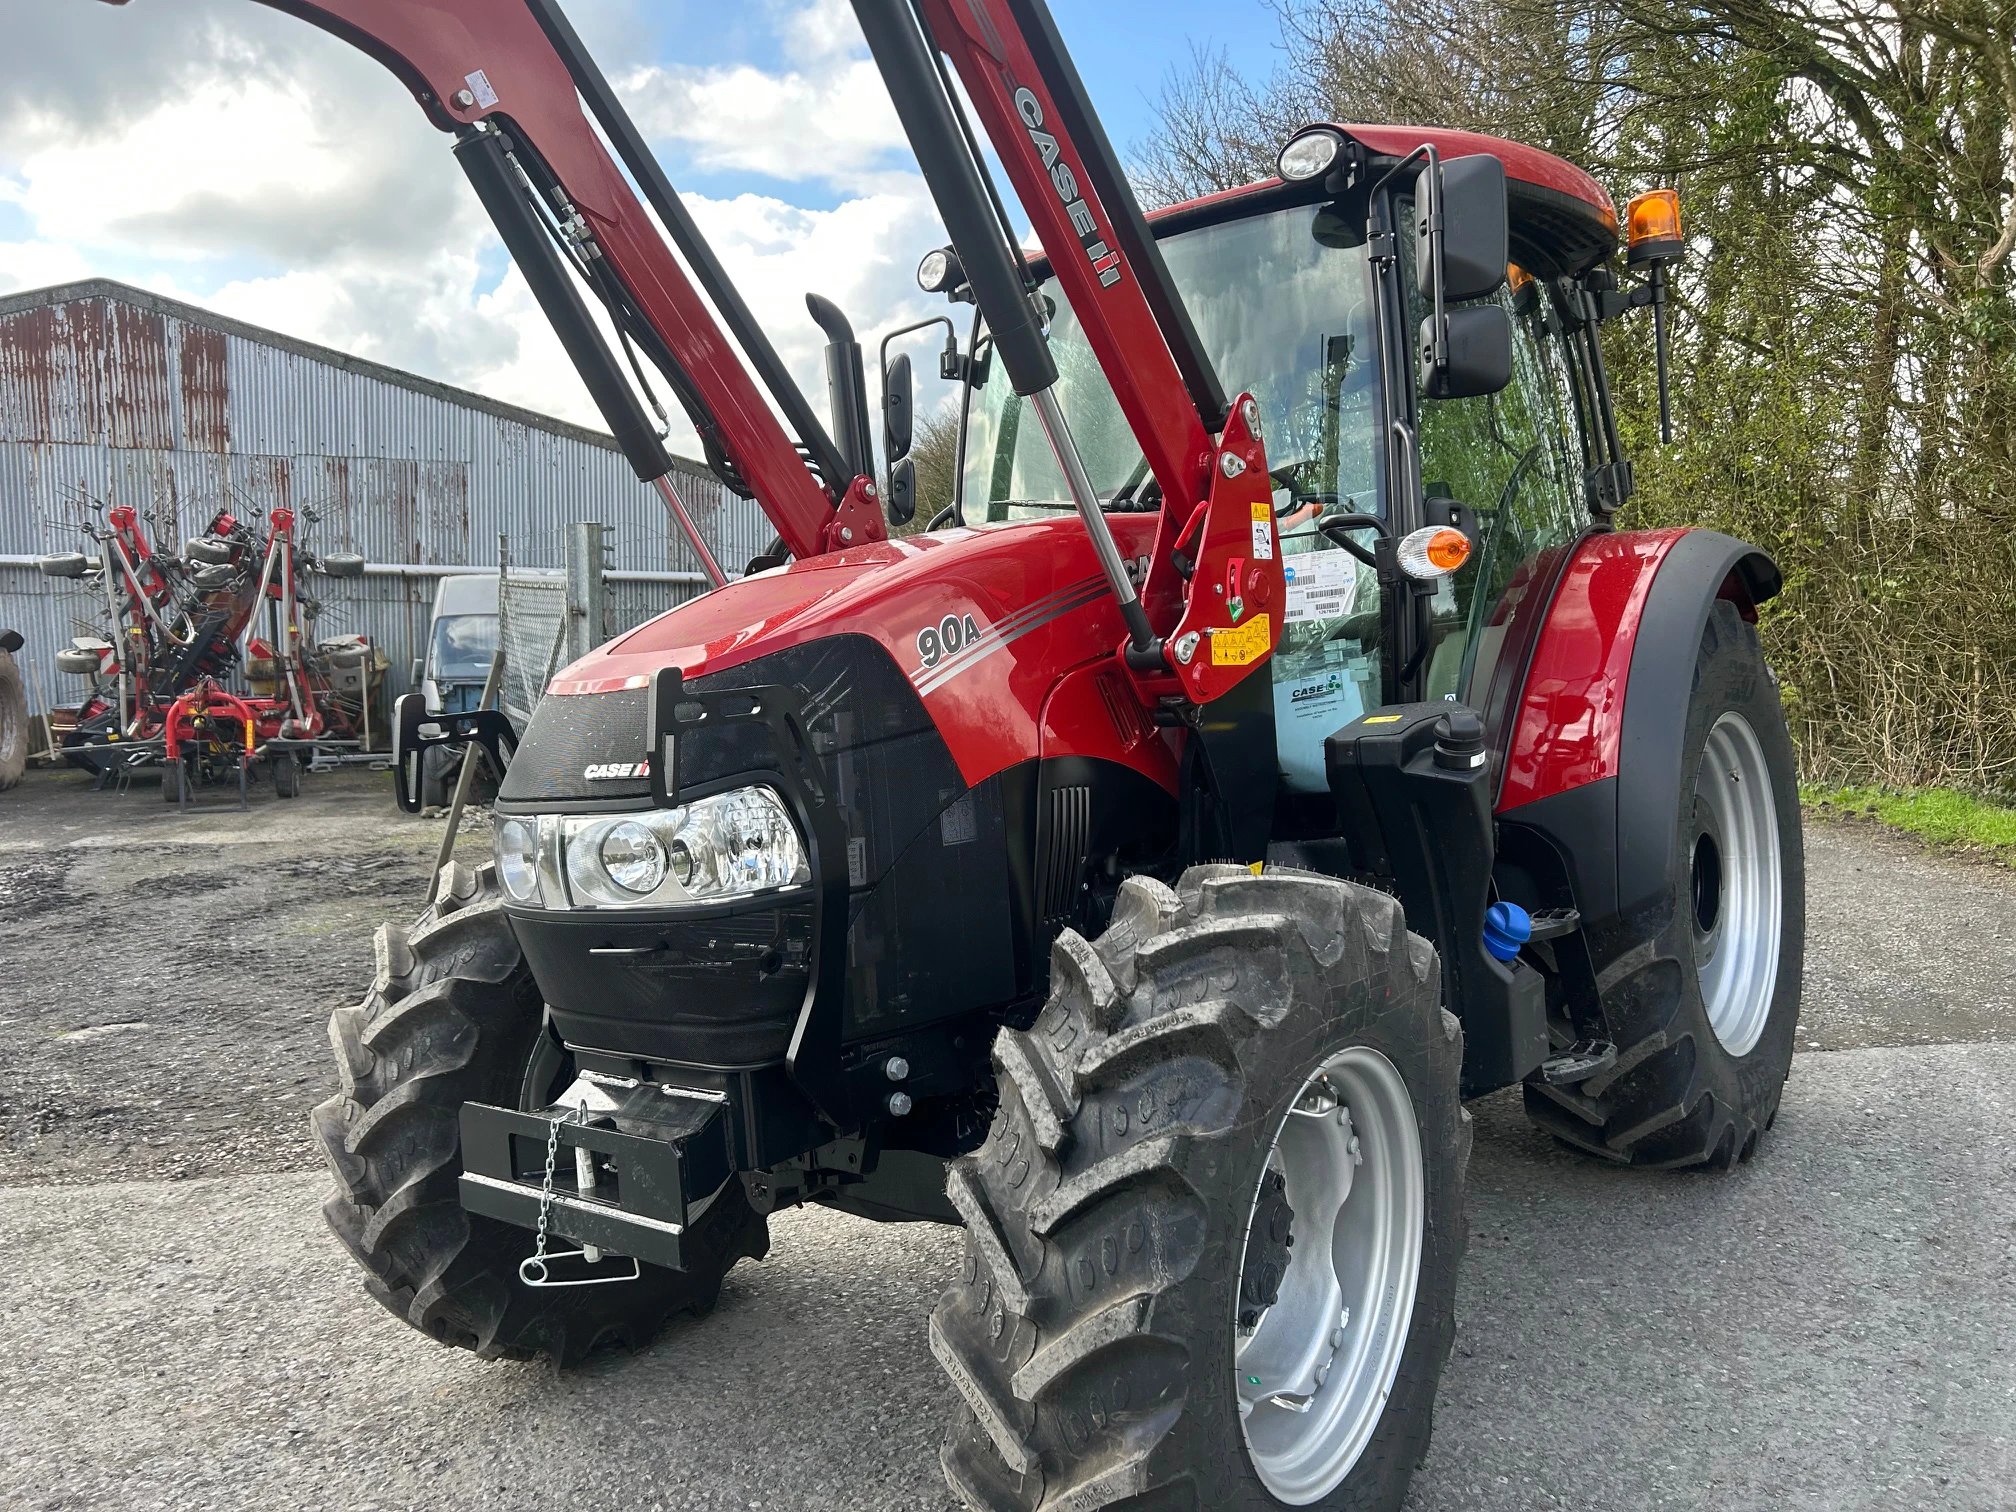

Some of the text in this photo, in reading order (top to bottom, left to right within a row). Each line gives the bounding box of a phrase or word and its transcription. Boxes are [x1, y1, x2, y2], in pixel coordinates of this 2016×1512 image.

[1014, 86, 1098, 238] CASE
[916, 612, 984, 670] 90A
[1293, 684, 1323, 697] CASE
[584, 763, 633, 779] CASE
